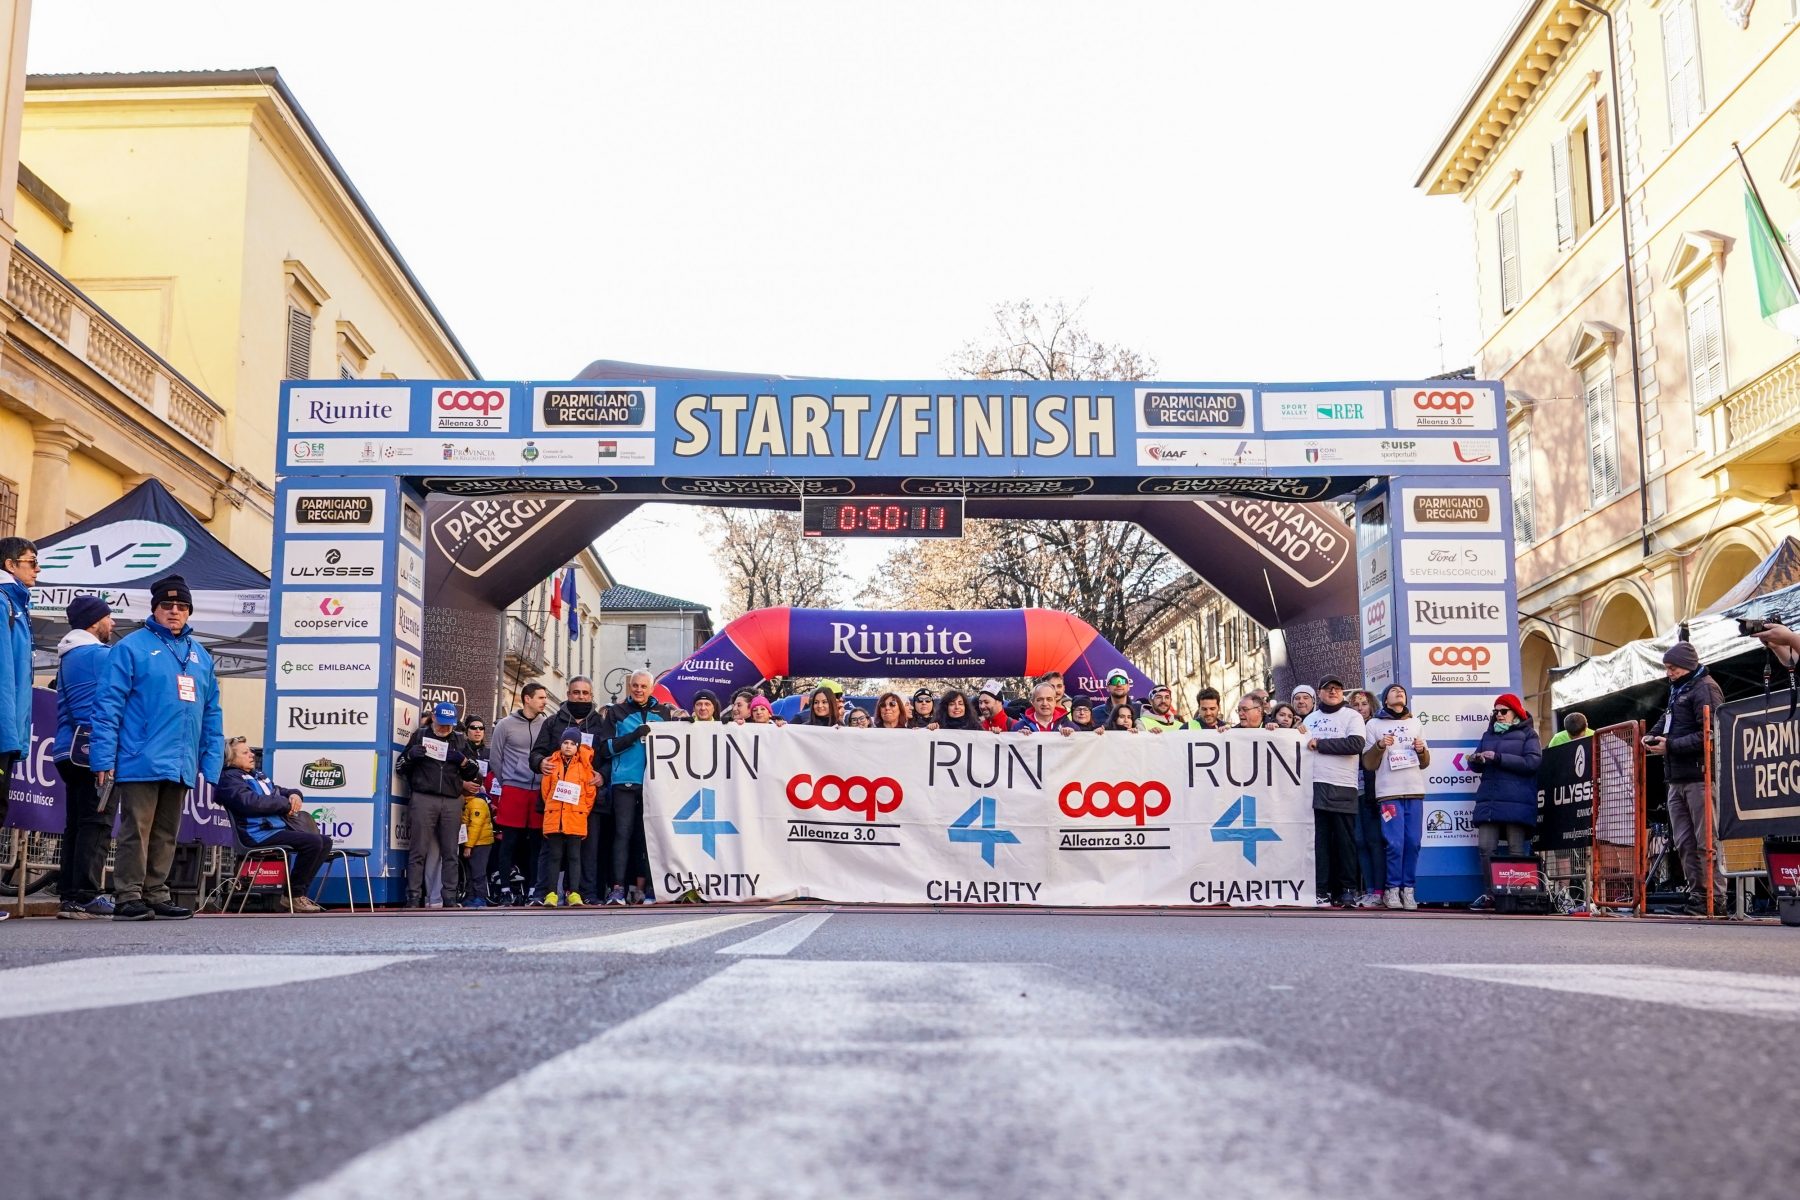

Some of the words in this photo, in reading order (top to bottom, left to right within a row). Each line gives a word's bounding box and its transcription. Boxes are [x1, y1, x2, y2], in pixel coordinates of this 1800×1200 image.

[438, 390, 504, 416] coop
[551, 394, 638, 408] PARMIGIANO
[1151, 395, 1237, 409] PARMIGIANO
[1413, 390, 1474, 415] coop
[308, 400, 393, 424] Riunite
[559, 408, 629, 421] REGGIANO
[1159, 409, 1230, 422] REGGIANO
[438, 418, 473, 428] Alleanza
[476, 419, 489, 427] 3.0
[673, 393, 1116, 460] START/FINISH
[1416, 417, 1448, 426] Alleanza
[1450, 417, 1462, 425] 3.0
[1391, 441, 1416, 450] UISP
[1161, 450, 1187, 458] IAAF
[301, 499, 367, 509] PARMIGIANO
[1419, 498, 1484, 508] PARMIGIANO
[307, 510, 361, 520] REGGIANO
[840, 506, 944, 530] 0:50:11
[1425, 509, 1478, 519] REGGIANO
[1216, 501, 1310, 561] GGIANO
[1427, 549, 1457, 562] Ford
[290, 567, 375, 577] ULYSSES
[1367, 600, 1386, 626] coop
[1414, 600, 1500, 625] Riunite
[294, 618, 369, 630] coopservice
[398, 606, 421, 637] Riunite
[829, 622, 972, 663] Riunite
[681, 657, 734, 673] Riunite
[886, 657, 893, 665] Il
[894, 657, 944, 665] Lambrusco
[946, 657, 955, 665] ci
[1429, 646, 1490, 671] coop
[1078, 676, 1134, 693] Riue
[1431, 674, 1464, 682] Alleanza
[1466, 674, 1478, 682] 3.0
[288, 706, 369, 730] Riunite
[1431, 714, 1450, 722] BCC
[1455, 714, 1490, 722] EMILBA
[649, 733, 759, 780] RUN
[1187, 740, 1301, 788] RUN
[928, 740, 1043, 790] RUN
[304, 769, 342, 779] Fattoria
[310, 777, 335, 787] Italia
[1429, 775, 1481, 786] coopser
[33, 792, 54, 807] unisce
[786, 773, 904, 821] coop
[1554, 780, 1600, 806] ULYSS
[1058, 780, 1171, 826] coop
[671, 787, 740, 861] 4
[947, 795, 1022, 869] 4
[1209, 794, 1283, 868] 4
[788, 825, 849, 840] Alleanza
[853, 827, 876, 841] 3.0
[1060, 833, 1120, 847] Alleanza
[1123, 833, 1146, 846] 3.0
[664, 871, 760, 896] CHARITY
[926, 879, 1042, 902] CHARITY
[1189, 879, 1305, 903] CHARITY
